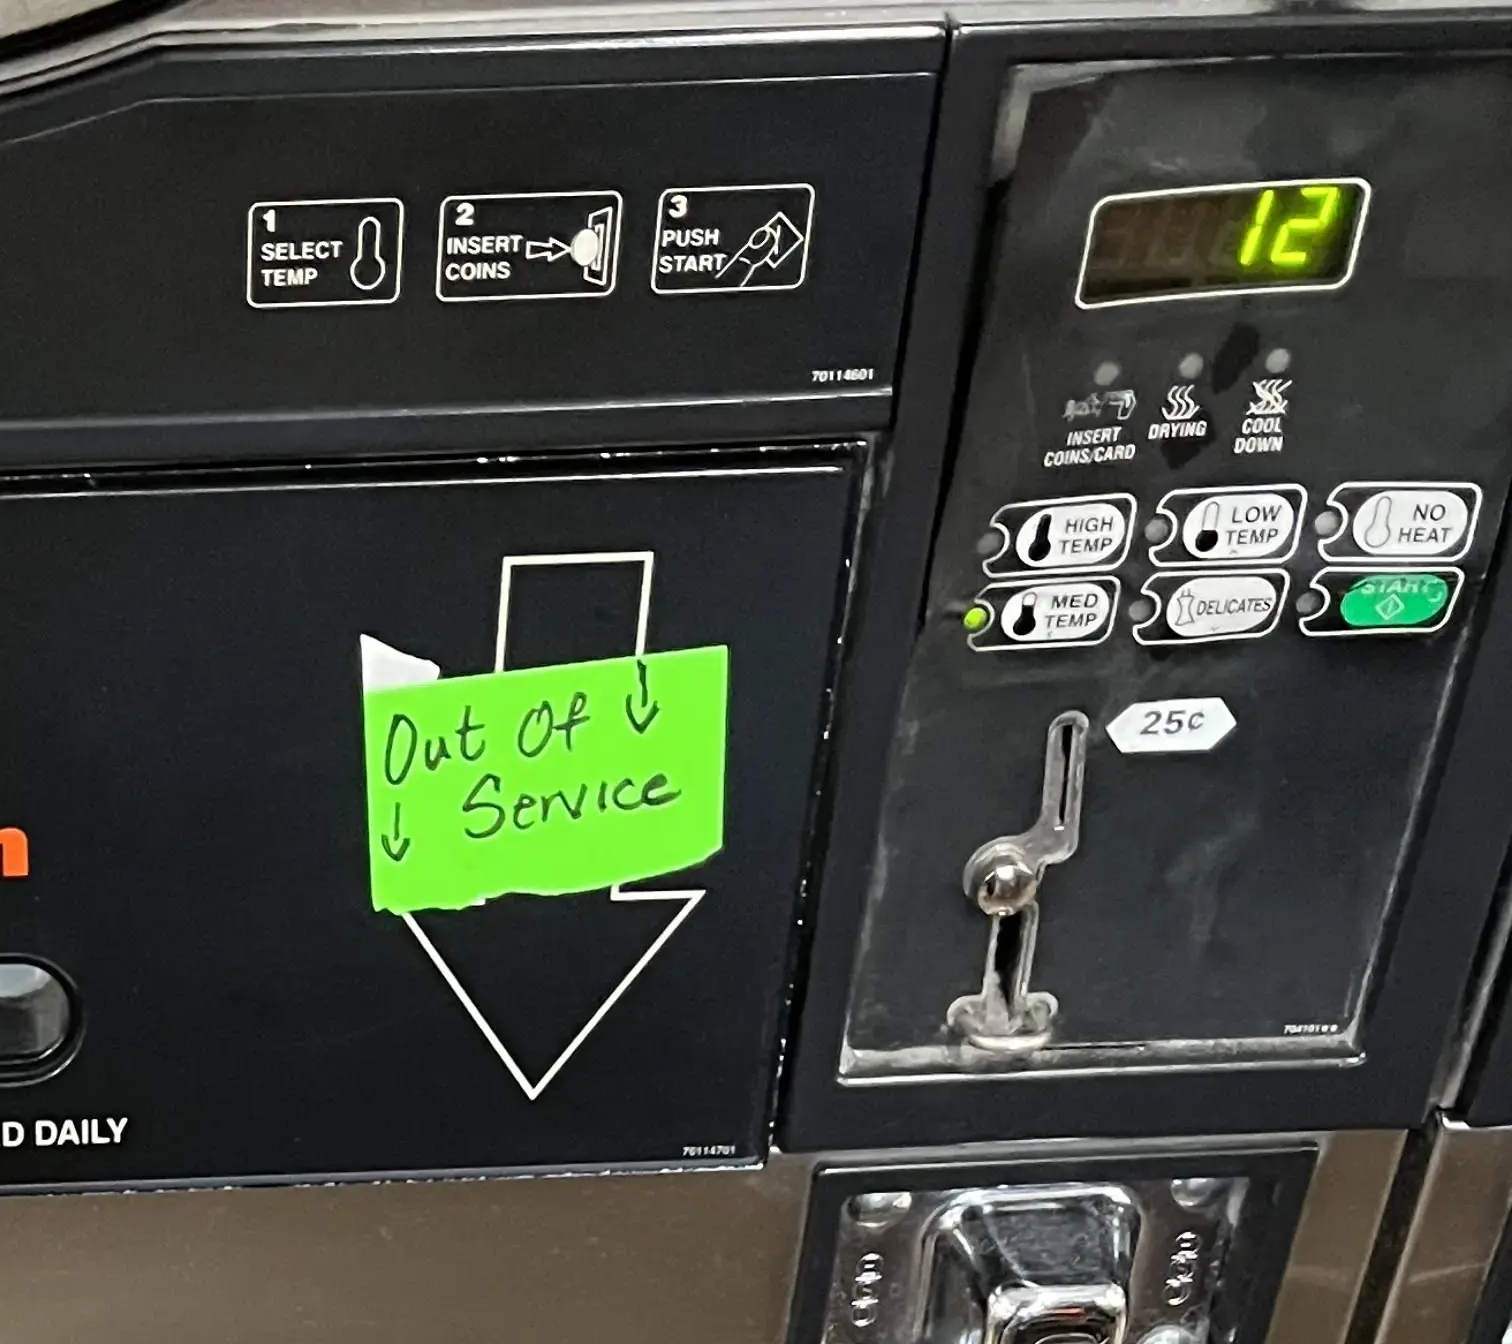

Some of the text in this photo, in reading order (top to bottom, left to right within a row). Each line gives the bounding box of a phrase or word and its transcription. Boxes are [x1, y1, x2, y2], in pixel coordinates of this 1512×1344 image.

[455, 202, 475, 226] 2
[668, 194, 688, 218] 3
[262, 209, 276, 233] 1
[1240, 187, 1341, 267] 12
[446, 234, 524, 255] INSERT
[661, 228, 720, 248] PUSH
[261, 240, 344, 262] SELECT
[445, 261, 511, 281] COINS
[658, 252, 728, 274] START
[260, 267, 318, 287] TEMP
[1066, 426, 1122, 446] INSERT
[1147, 420, 1208, 440] DRYING
[1241, 417, 1282, 435] COOL
[1043, 443, 1136, 467] COINS/CARD
[1233, 436, 1284, 454] DOWN
[1231, 505, 1282, 524] LOW
[1413, 504, 1446, 522] NO
[1065, 517, 1114, 533] HIGH
[1398, 527, 1451, 543] HEAT
[1061, 537, 1113, 554] TEMP
[1227, 528, 1279, 545] TEMP
[1051, 593, 1099, 609] MED
[1196, 597, 1275, 616] DELICATES
[1045, 612, 1097, 628] TEMP
[1139, 710, 1205, 735] 25¢
[385, 691, 590, 786] Out Of
[461, 774, 682, 839] Service
[35, 1117, 128, 1146] DAILY
